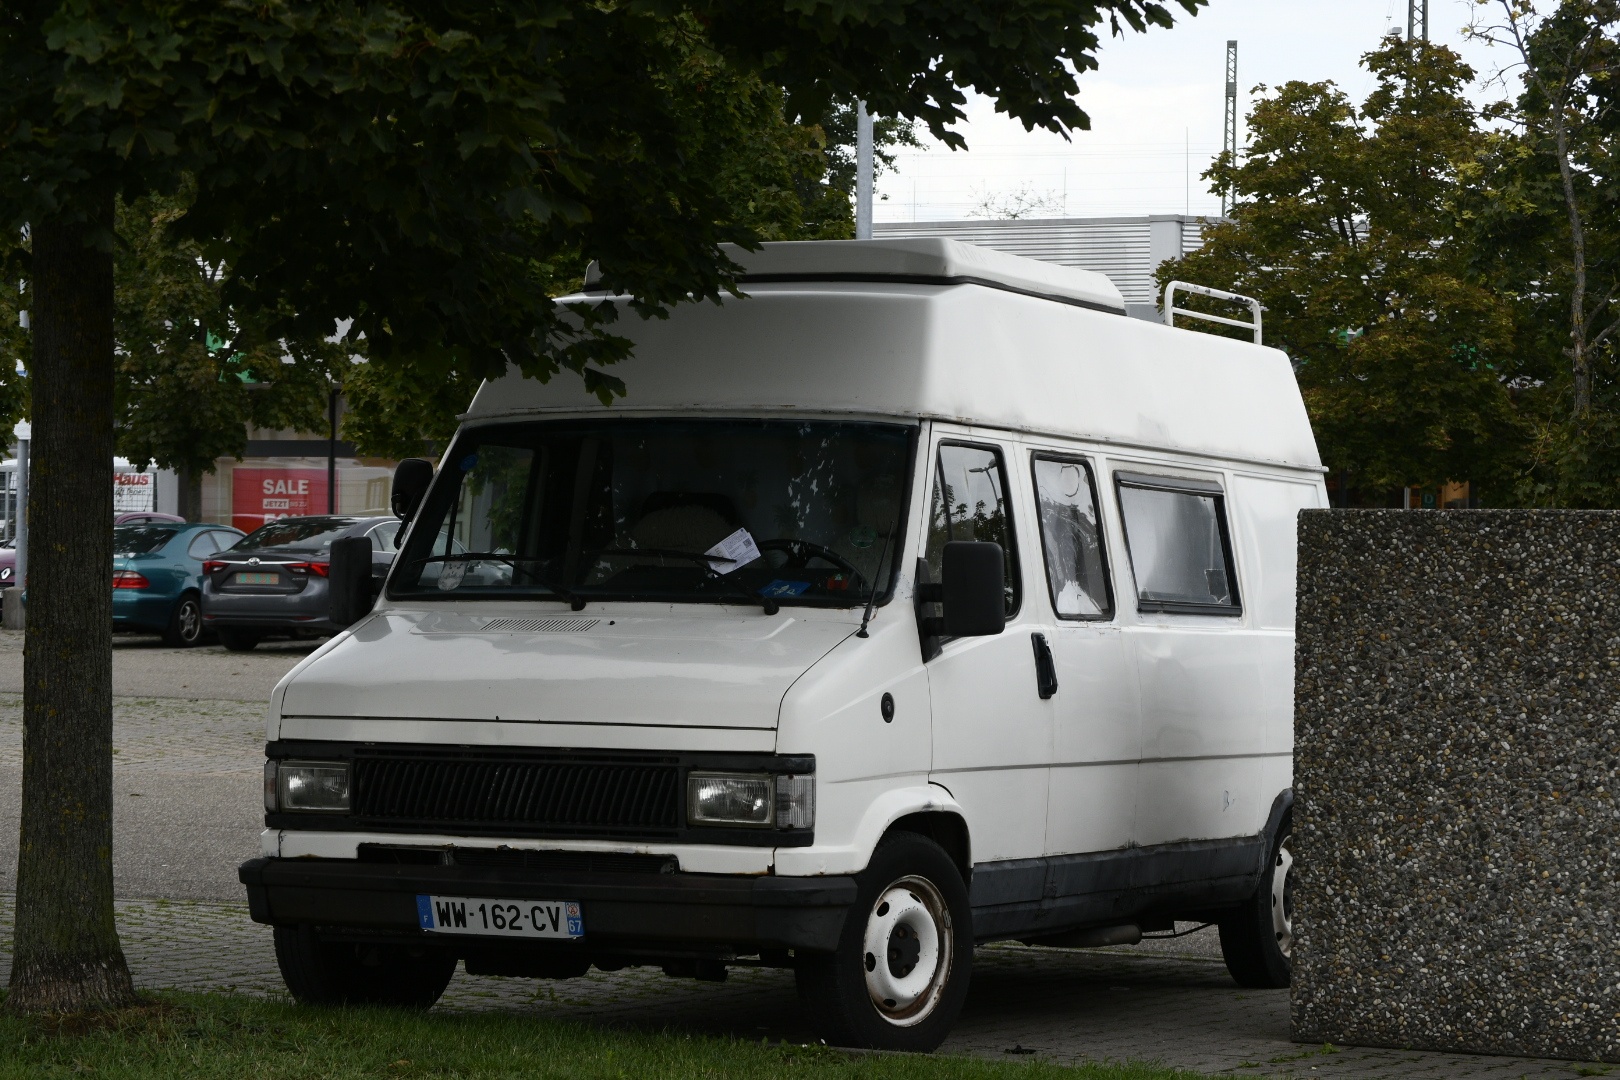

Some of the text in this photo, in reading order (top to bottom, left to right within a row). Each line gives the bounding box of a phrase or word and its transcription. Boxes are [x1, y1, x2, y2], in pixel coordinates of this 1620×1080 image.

[262, 479, 309, 495] SALE
[423, 915, 429, 923] F
[436, 901, 560, 932] WW-162-CV
[568, 919, 581, 933] 67
